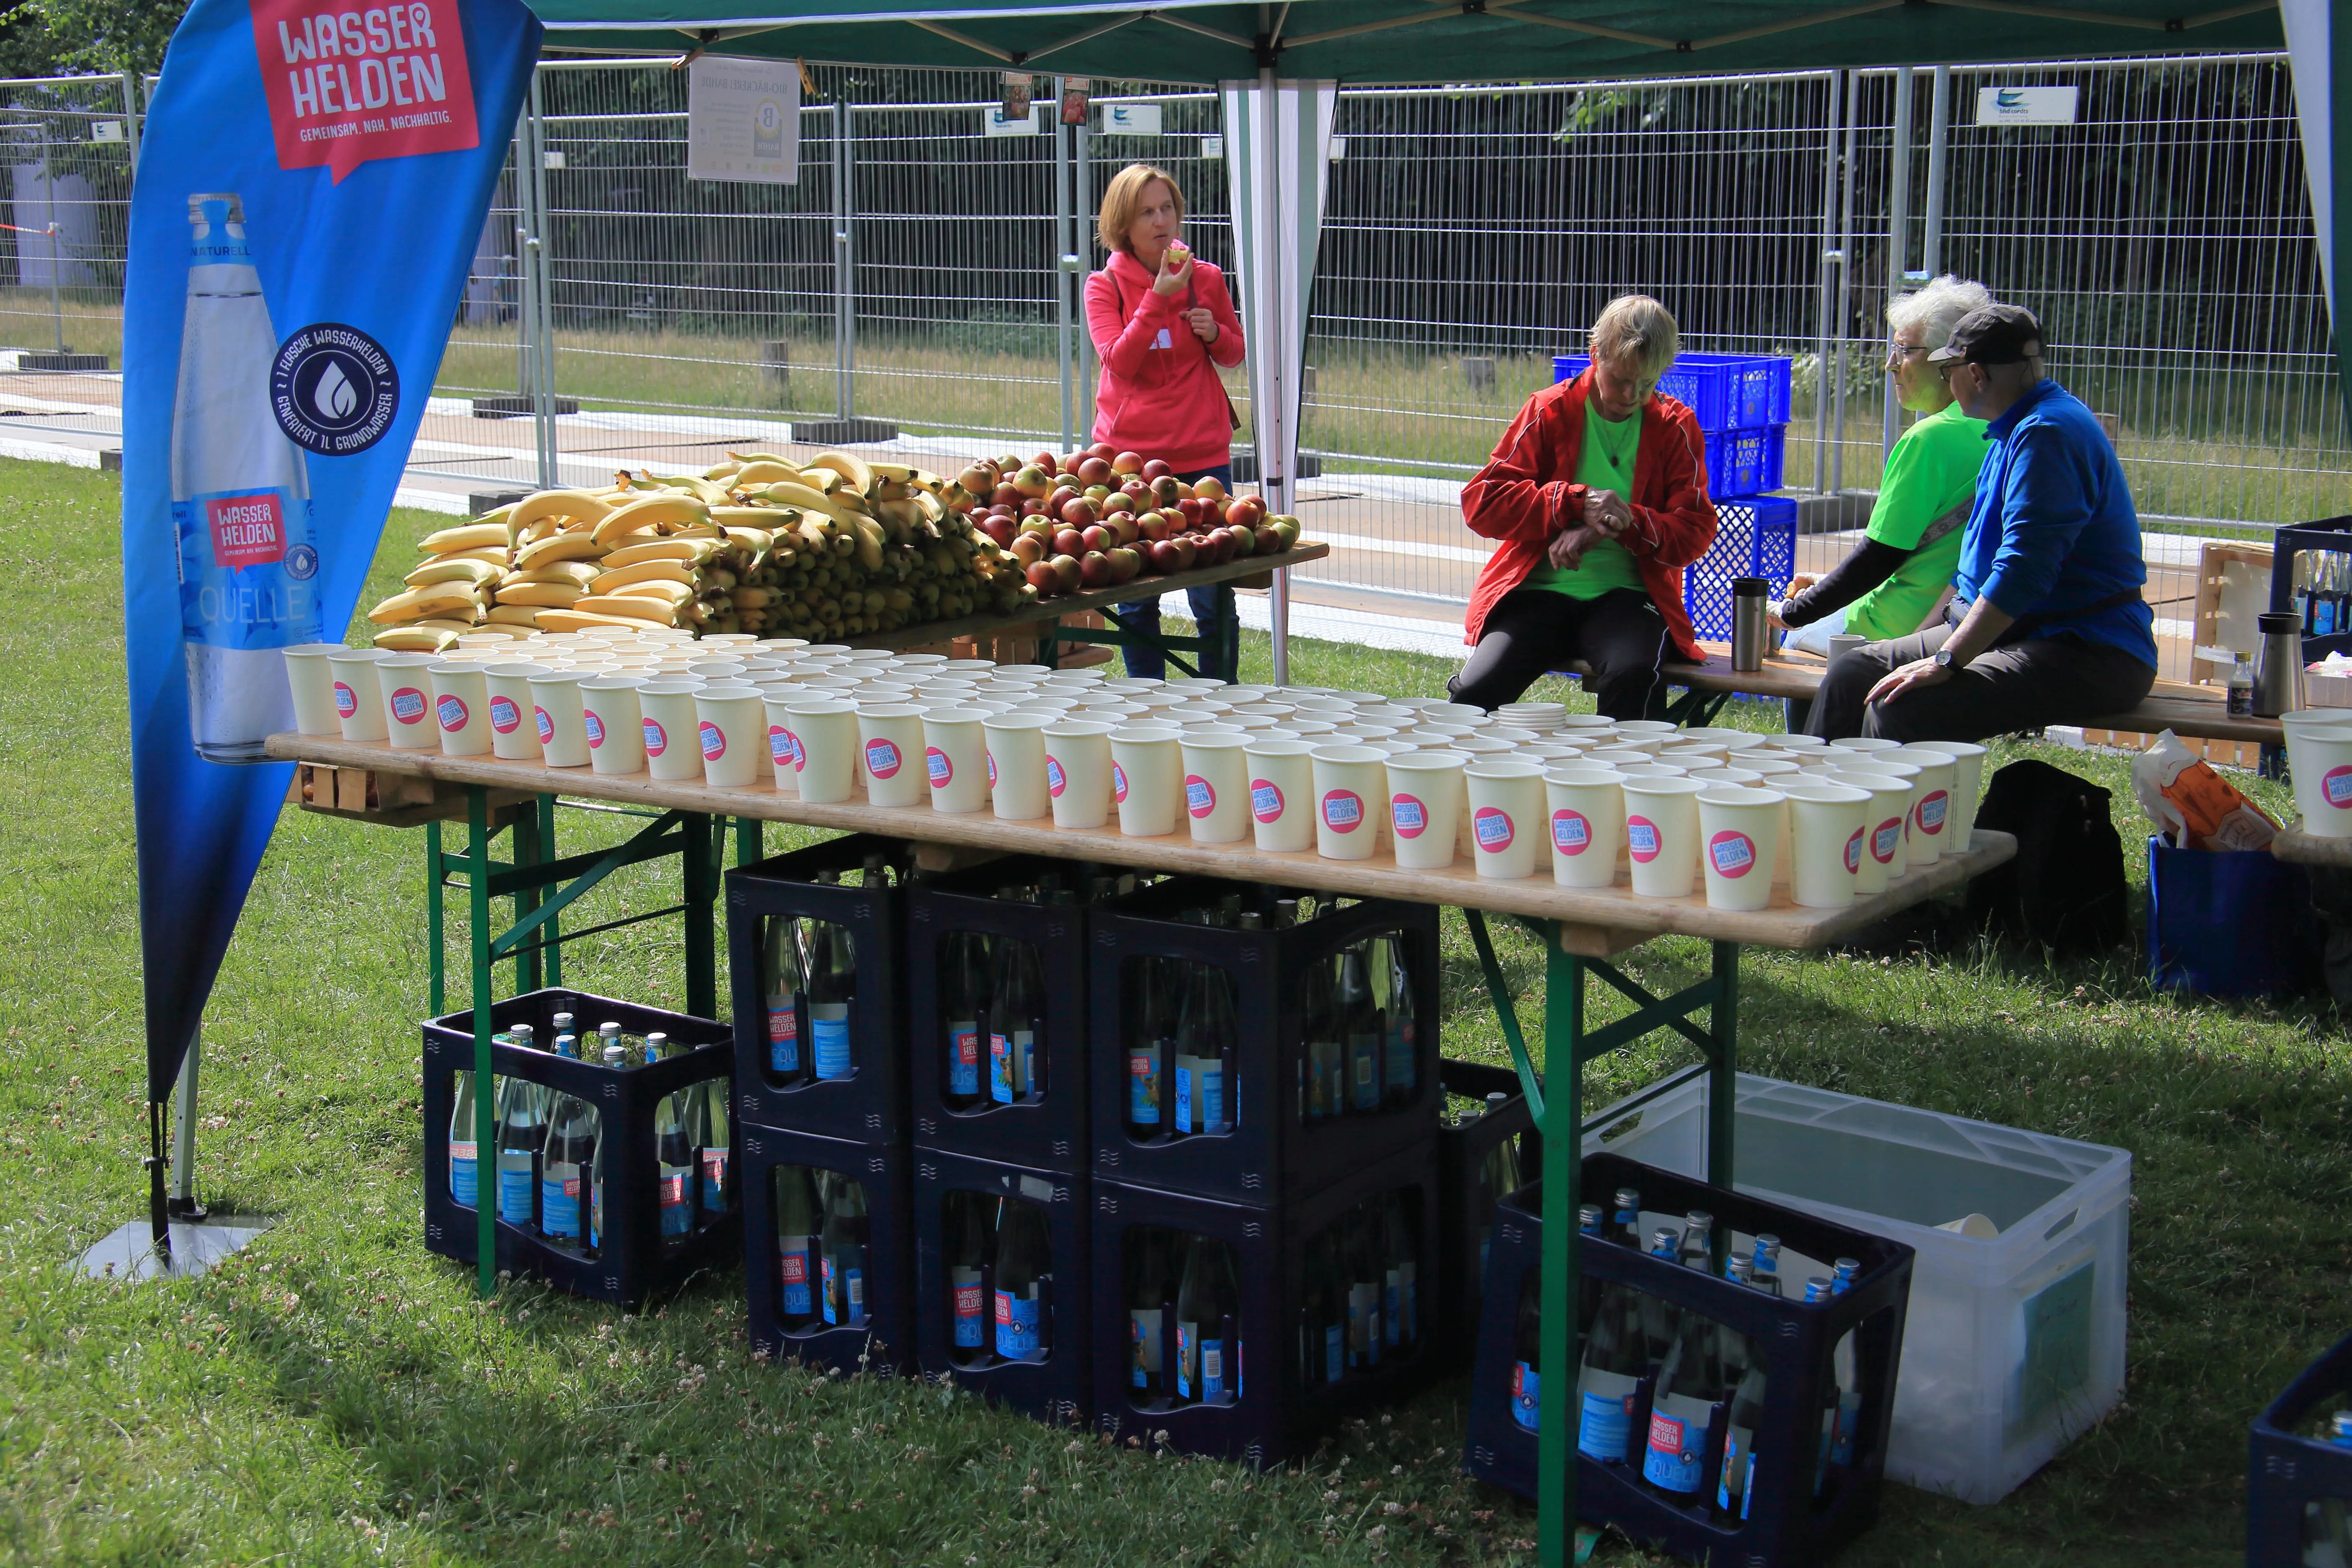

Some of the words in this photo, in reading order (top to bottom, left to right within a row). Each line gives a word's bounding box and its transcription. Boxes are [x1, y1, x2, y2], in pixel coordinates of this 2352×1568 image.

[278, 3, 436, 63] WASSER
[290, 53, 446, 118] HELDEN
[300, 124, 361, 142] GEMEINSAM.
[364, 120, 389, 133] NAH.
[391, 110, 452, 130] NACHHALTIG.
[190, 246, 251, 256] NATURELL
[279, 334, 313, 371] FLASCHE
[313, 329, 389, 375] WASSERHELDEN
[277, 395, 317, 444] GENERIERT
[335, 393, 393, 450] GRUNDWASSER
[217, 503, 273, 526] WASSER
[220, 523, 276, 547] HELDEN
[199, 585, 305, 626] QUELLE
[394, 694, 420, 704] WASSER
[398, 701, 422, 713] HELDEN
[871, 753, 895, 766] HELDEN
[1326, 798, 1356, 809] WASSER
[1328, 807, 1357, 818] HELDEN
[1717, 847, 1749, 864] HELDEN
[769, 1013, 795, 1024] WASSER
[770, 1022, 797, 1033] HELDEN
[962, 1037, 977, 1046] WAS
[963, 1045, 977, 1056] HEL
[660, 1181, 680, 1191] ASSER
[660, 1189, 681, 1200] ELDEN
[785, 1292, 810, 1306] QUE
[957, 1288, 982, 1299] WASSE
[958, 1297, 982, 1308] HELDE
[1653, 1417, 1678, 1435] WASSER
[1652, 1426, 1678, 1445] HELDEN
